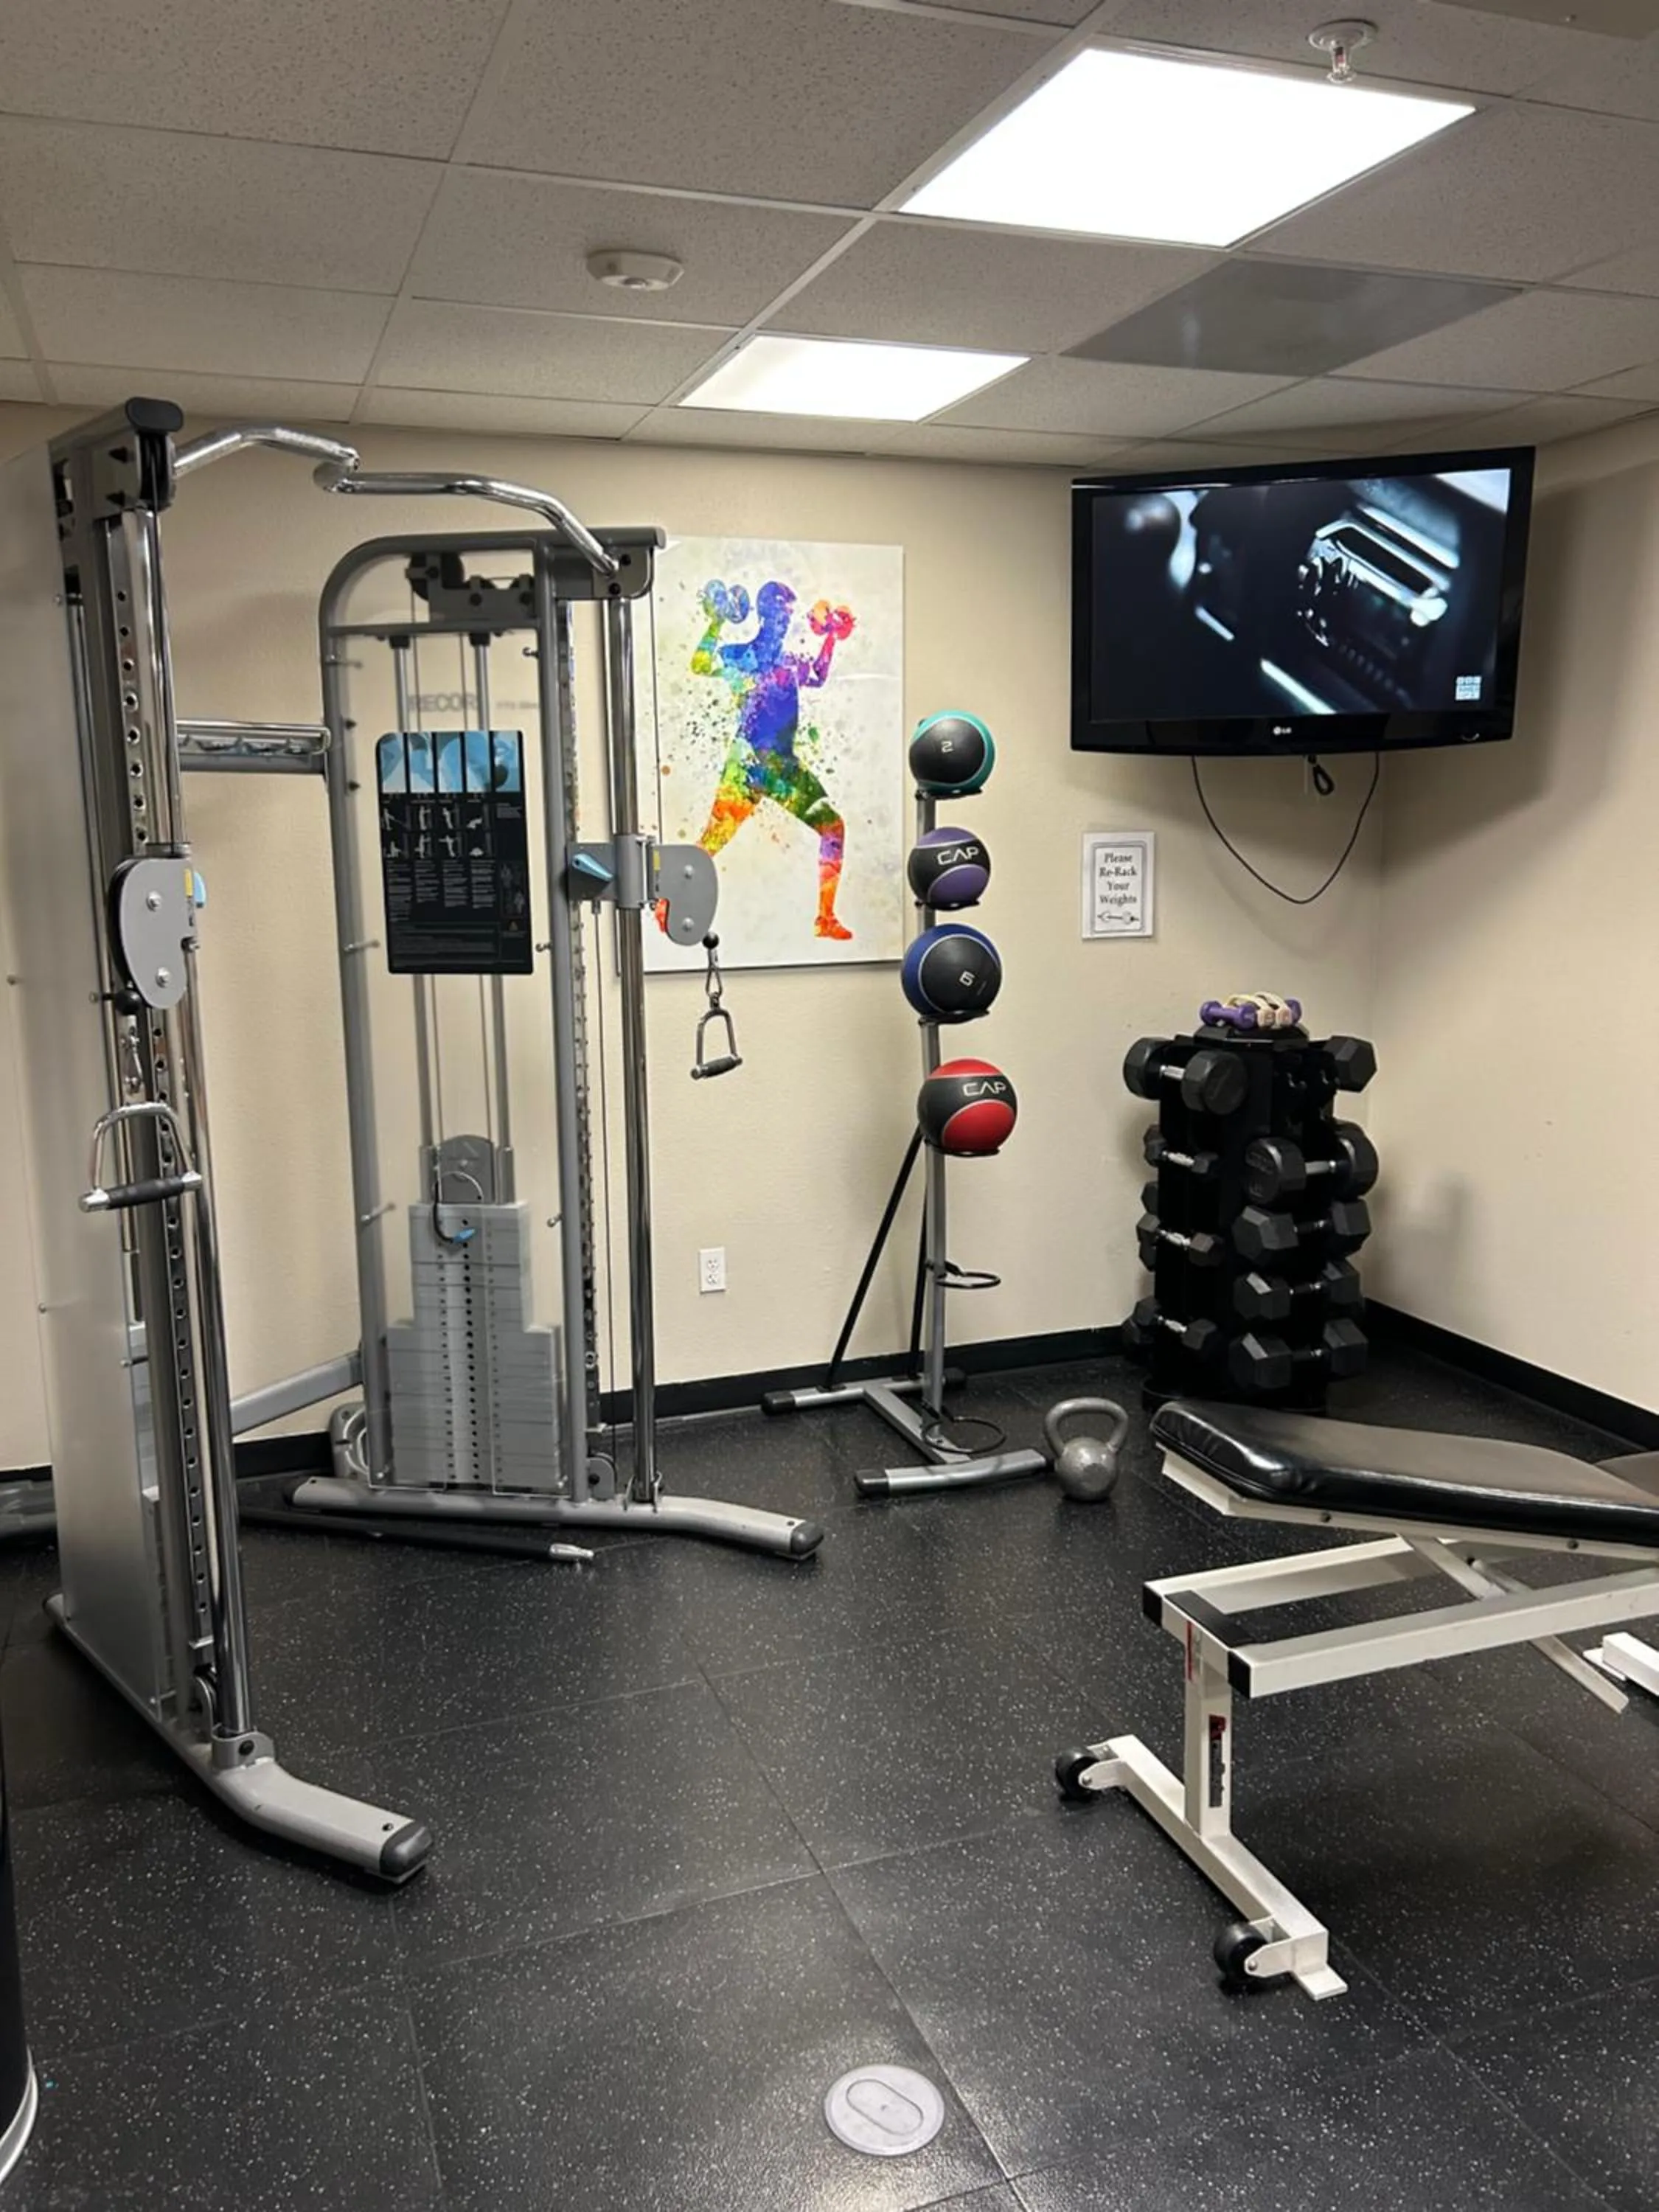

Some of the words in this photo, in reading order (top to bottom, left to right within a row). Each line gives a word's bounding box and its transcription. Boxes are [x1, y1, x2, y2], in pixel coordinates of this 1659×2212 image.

[941, 741, 953, 753] 2
[936, 846, 979, 866] CAP
[1104, 852, 1133, 863] Please
[1099, 866, 1138, 877] Re-Rack
[1107, 881, 1130, 891] Your
[1099, 893, 1138, 907] Weights
[961, 1082, 1006, 1097] CAP
